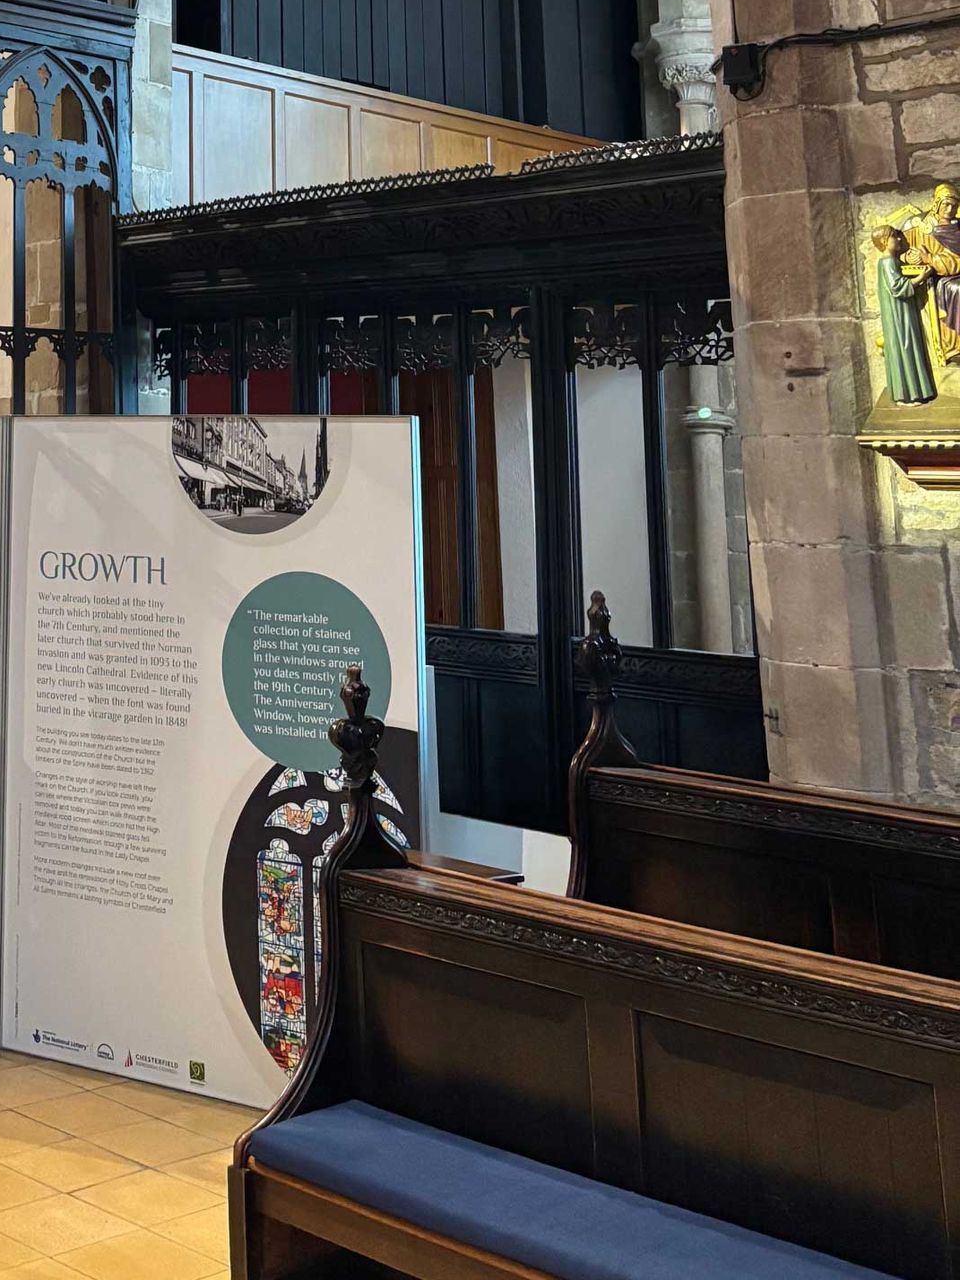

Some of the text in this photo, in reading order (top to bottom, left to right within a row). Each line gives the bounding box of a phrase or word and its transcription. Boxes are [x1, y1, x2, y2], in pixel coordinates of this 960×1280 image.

[40, 551, 167, 585] GROWTH
[38, 592, 165, 610] We've already looked at the tiny
[37, 606, 185, 624] church which probably stood here in
[274, 611, 329, 624] remarkable
[38, 620, 51, 629] the
[52, 621, 64, 630] 7th
[103, 624, 118, 634] and
[120, 625, 164, 637] mentioned
[166, 629, 180, 639] the
[253, 623, 351, 640] collection of stained
[37, 633, 192, 654] later church that survived the Norman
[253, 638, 360, 655] glass that you can see
[37, 647, 69, 658] invasion
[71, 650, 86, 660] and
[106, 653, 138, 666] granted
[140, 656, 148, 665] in
[150, 657, 170, 667] 1093
[172, 658, 181, 668] to
[183, 659, 198, 669] the
[253, 652, 262, 662] in
[265, 653, 280, 664] the
[283, 654, 326, 667] windows
[37, 663, 53, 671] new
[55, 663, 84, 674] Lincoln
[130, 669, 169, 681] Evidence
[171, 673, 180, 682] of
[182, 674, 198, 684] this
[253, 669, 271, 681] you
[273, 668, 300, 679] dates
[302, 670, 335, 685] mostly
[37, 675, 192, 700] early church was uncovered literally
[254, 680, 336, 699] the 19th Century.
[37, 689, 191, 713] uncovered when the font was found
[253, 695, 335, 713] The Anniversary
[36, 703, 61, 714] buried
[63, 706, 71, 715] in
[73, 707, 86, 717] the
[88, 708, 122, 722] vicarage
[124, 712, 153, 726] garden
[155, 715, 163, 725] in
[253, 709, 295, 725] Window,
[254, 725, 329, 739] was installed in
